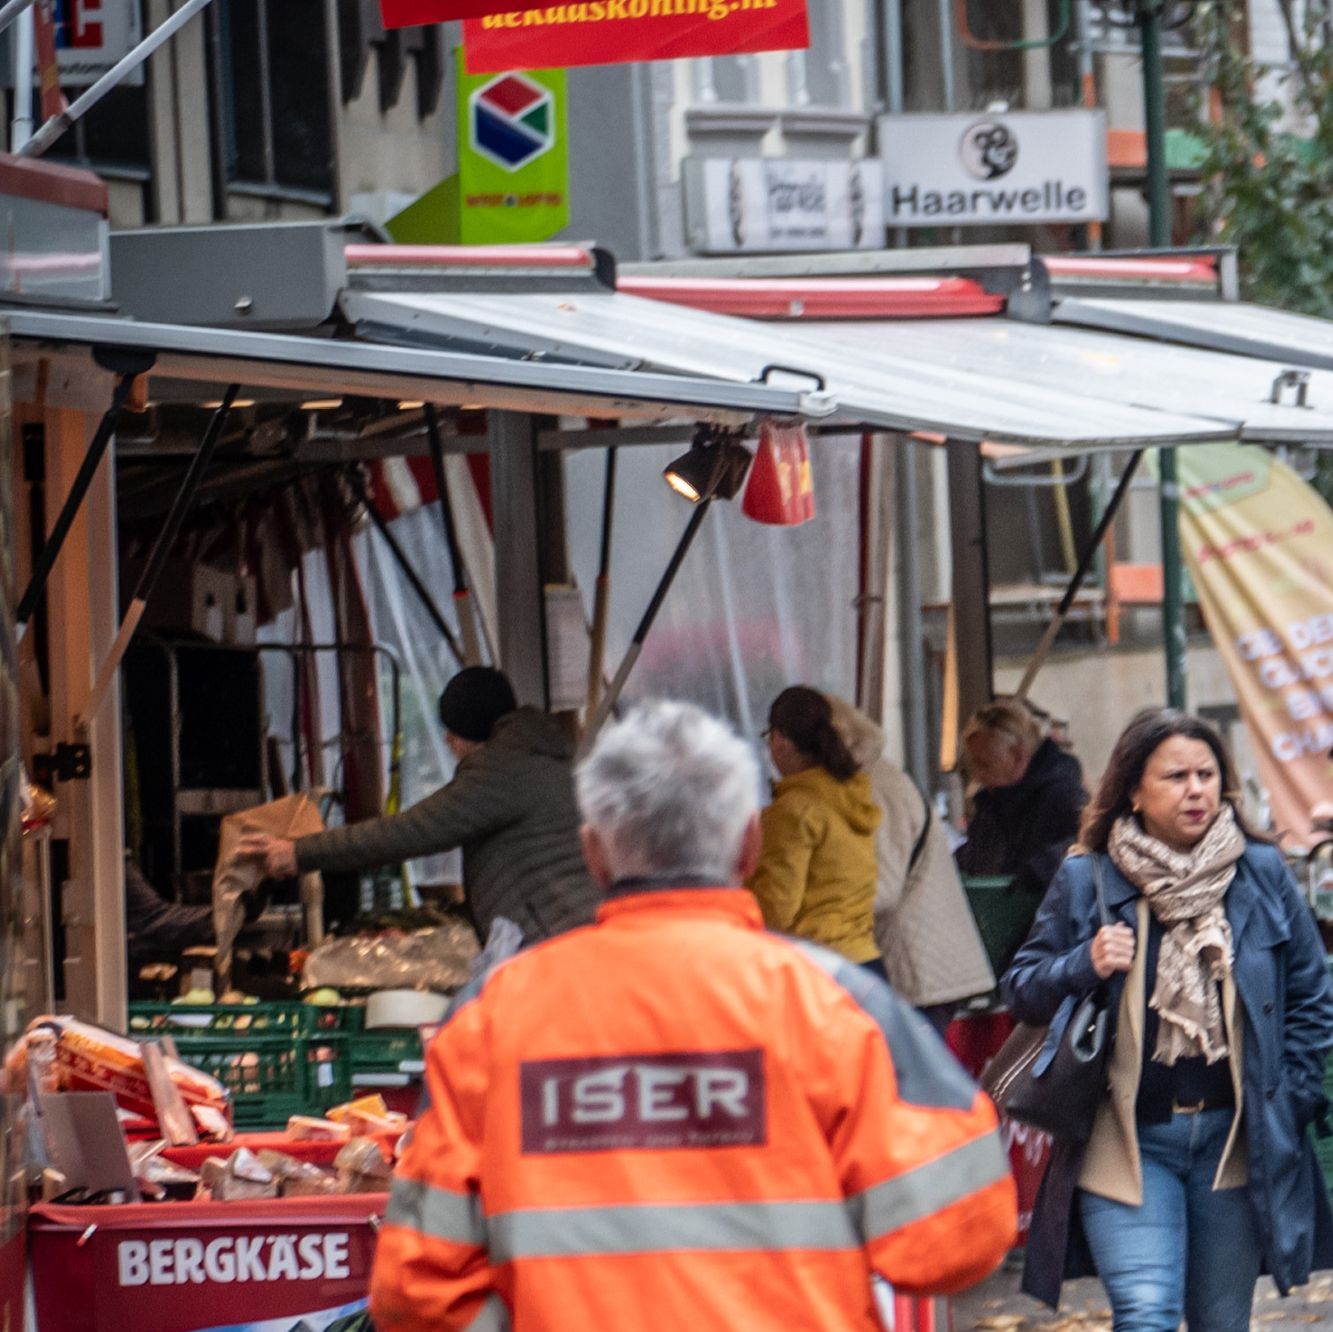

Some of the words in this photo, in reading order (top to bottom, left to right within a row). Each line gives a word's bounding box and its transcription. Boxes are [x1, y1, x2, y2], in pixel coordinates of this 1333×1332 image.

[891, 180, 1087, 216] Haarwelle
[541, 1065, 749, 1126] ISER
[118, 1233, 350, 1287] BERGKÄSE
